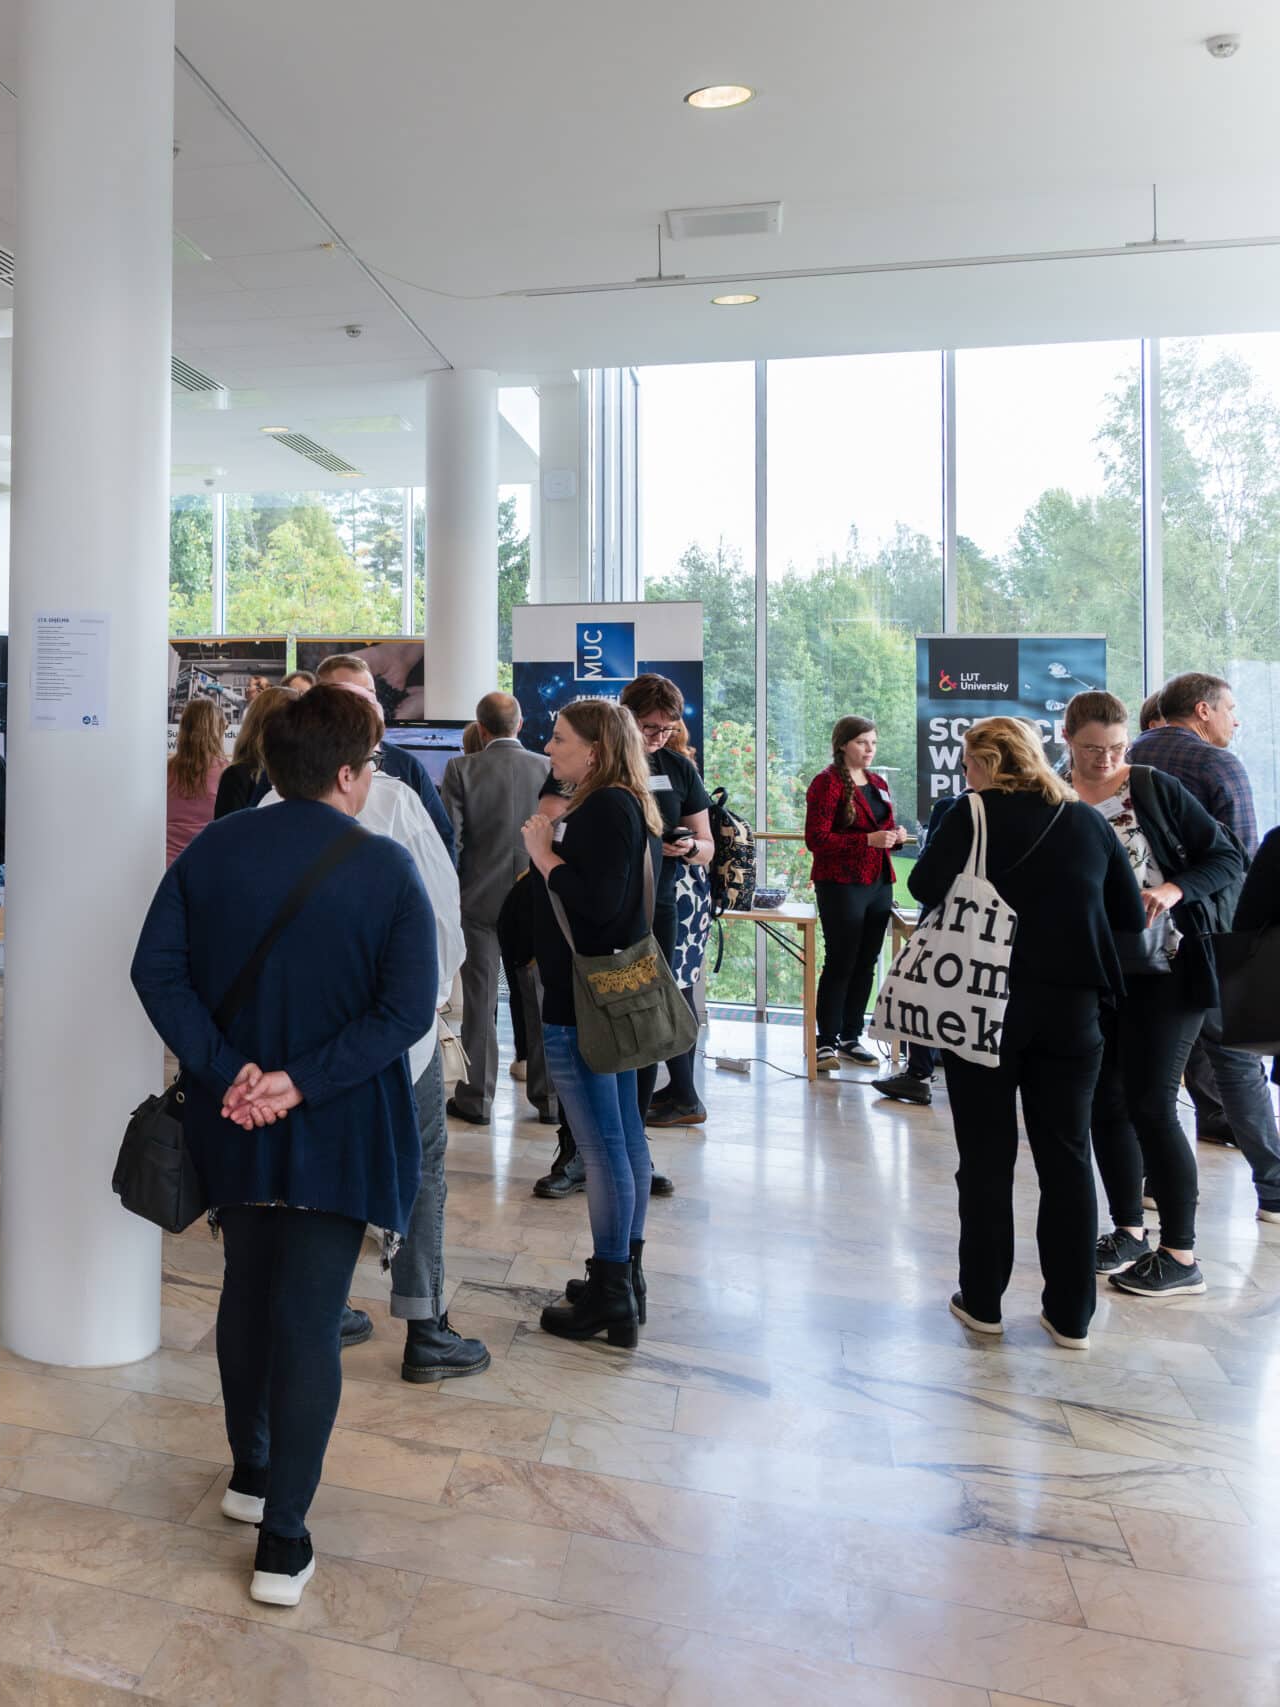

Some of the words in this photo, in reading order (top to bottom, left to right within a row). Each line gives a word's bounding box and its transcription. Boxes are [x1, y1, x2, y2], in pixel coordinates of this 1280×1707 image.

[583, 629, 603, 678] MUC
[960, 672, 981, 682] LUT
[960, 682, 1009, 693] University
